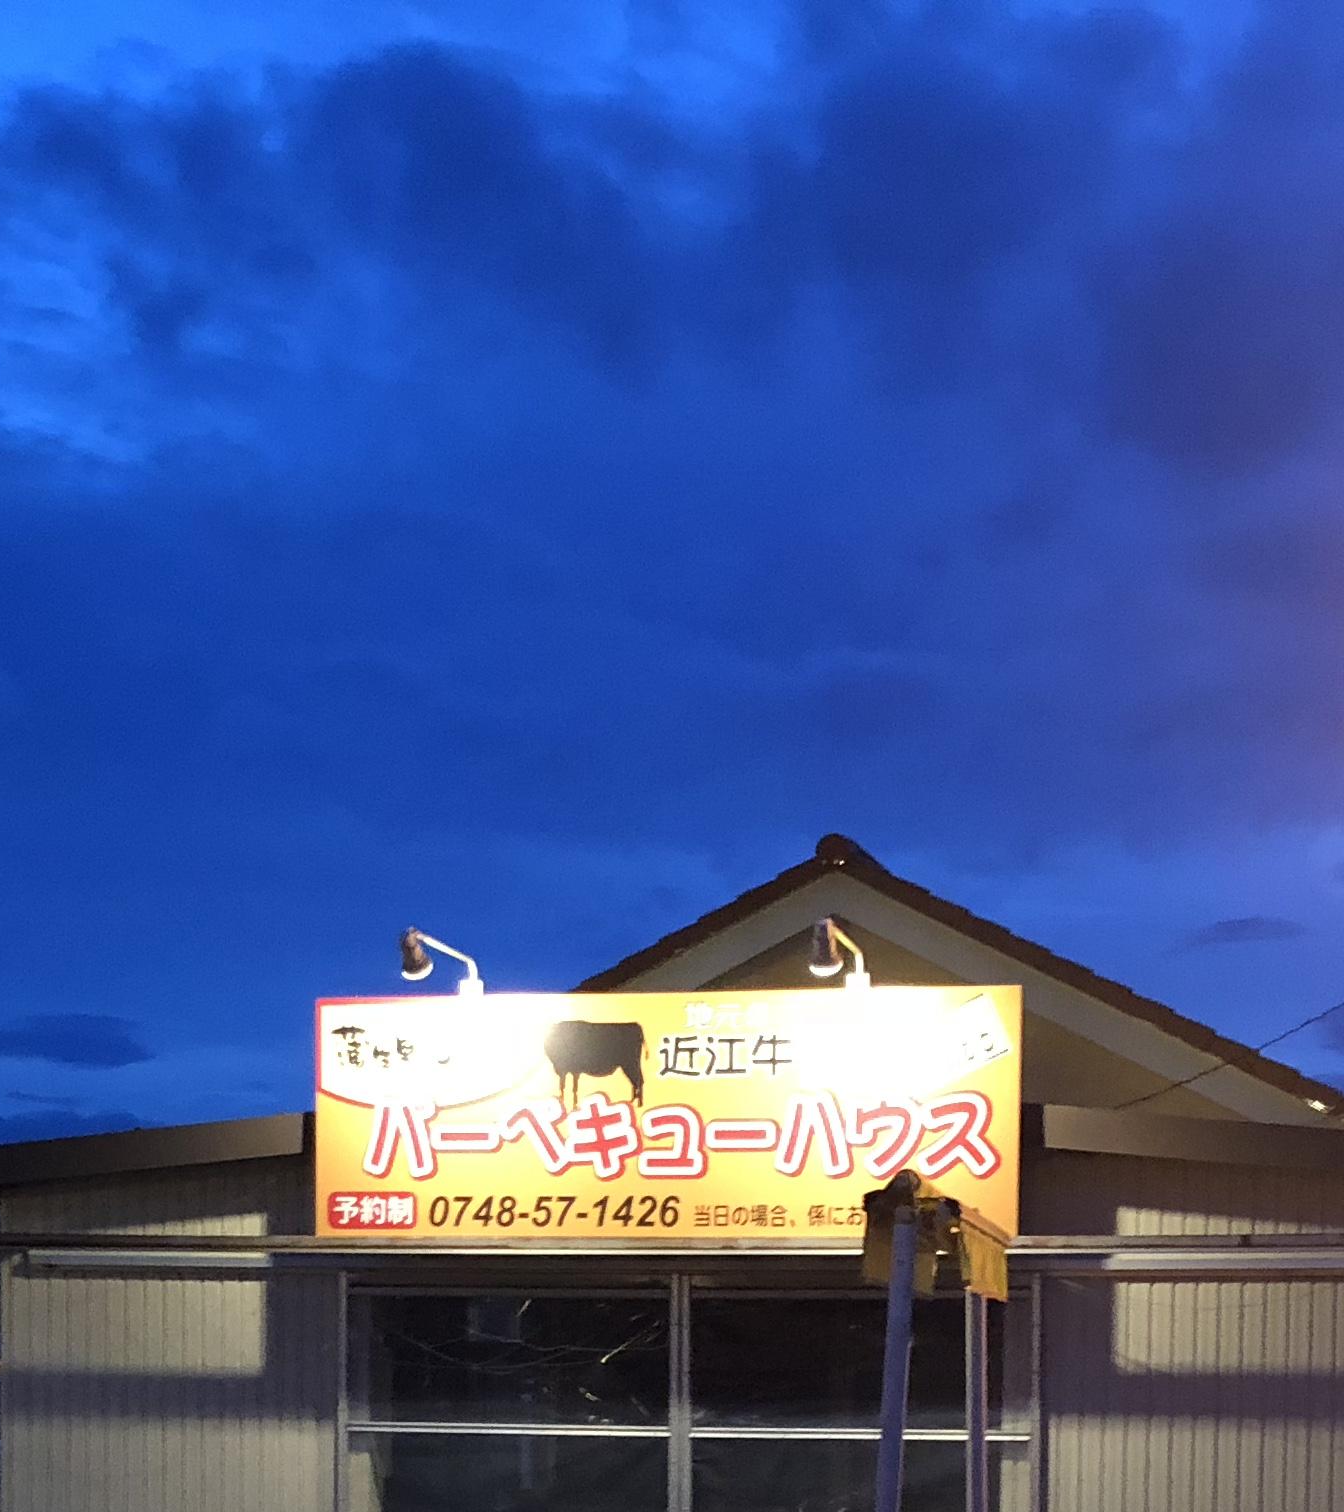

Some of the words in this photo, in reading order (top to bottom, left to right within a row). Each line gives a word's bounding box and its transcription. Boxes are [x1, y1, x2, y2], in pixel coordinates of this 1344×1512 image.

[659, 1034, 792, 1076] 近江牛
[333, 1196, 414, 1226] 予約制
[429, 1196, 680, 1227] 0748-57-1426
